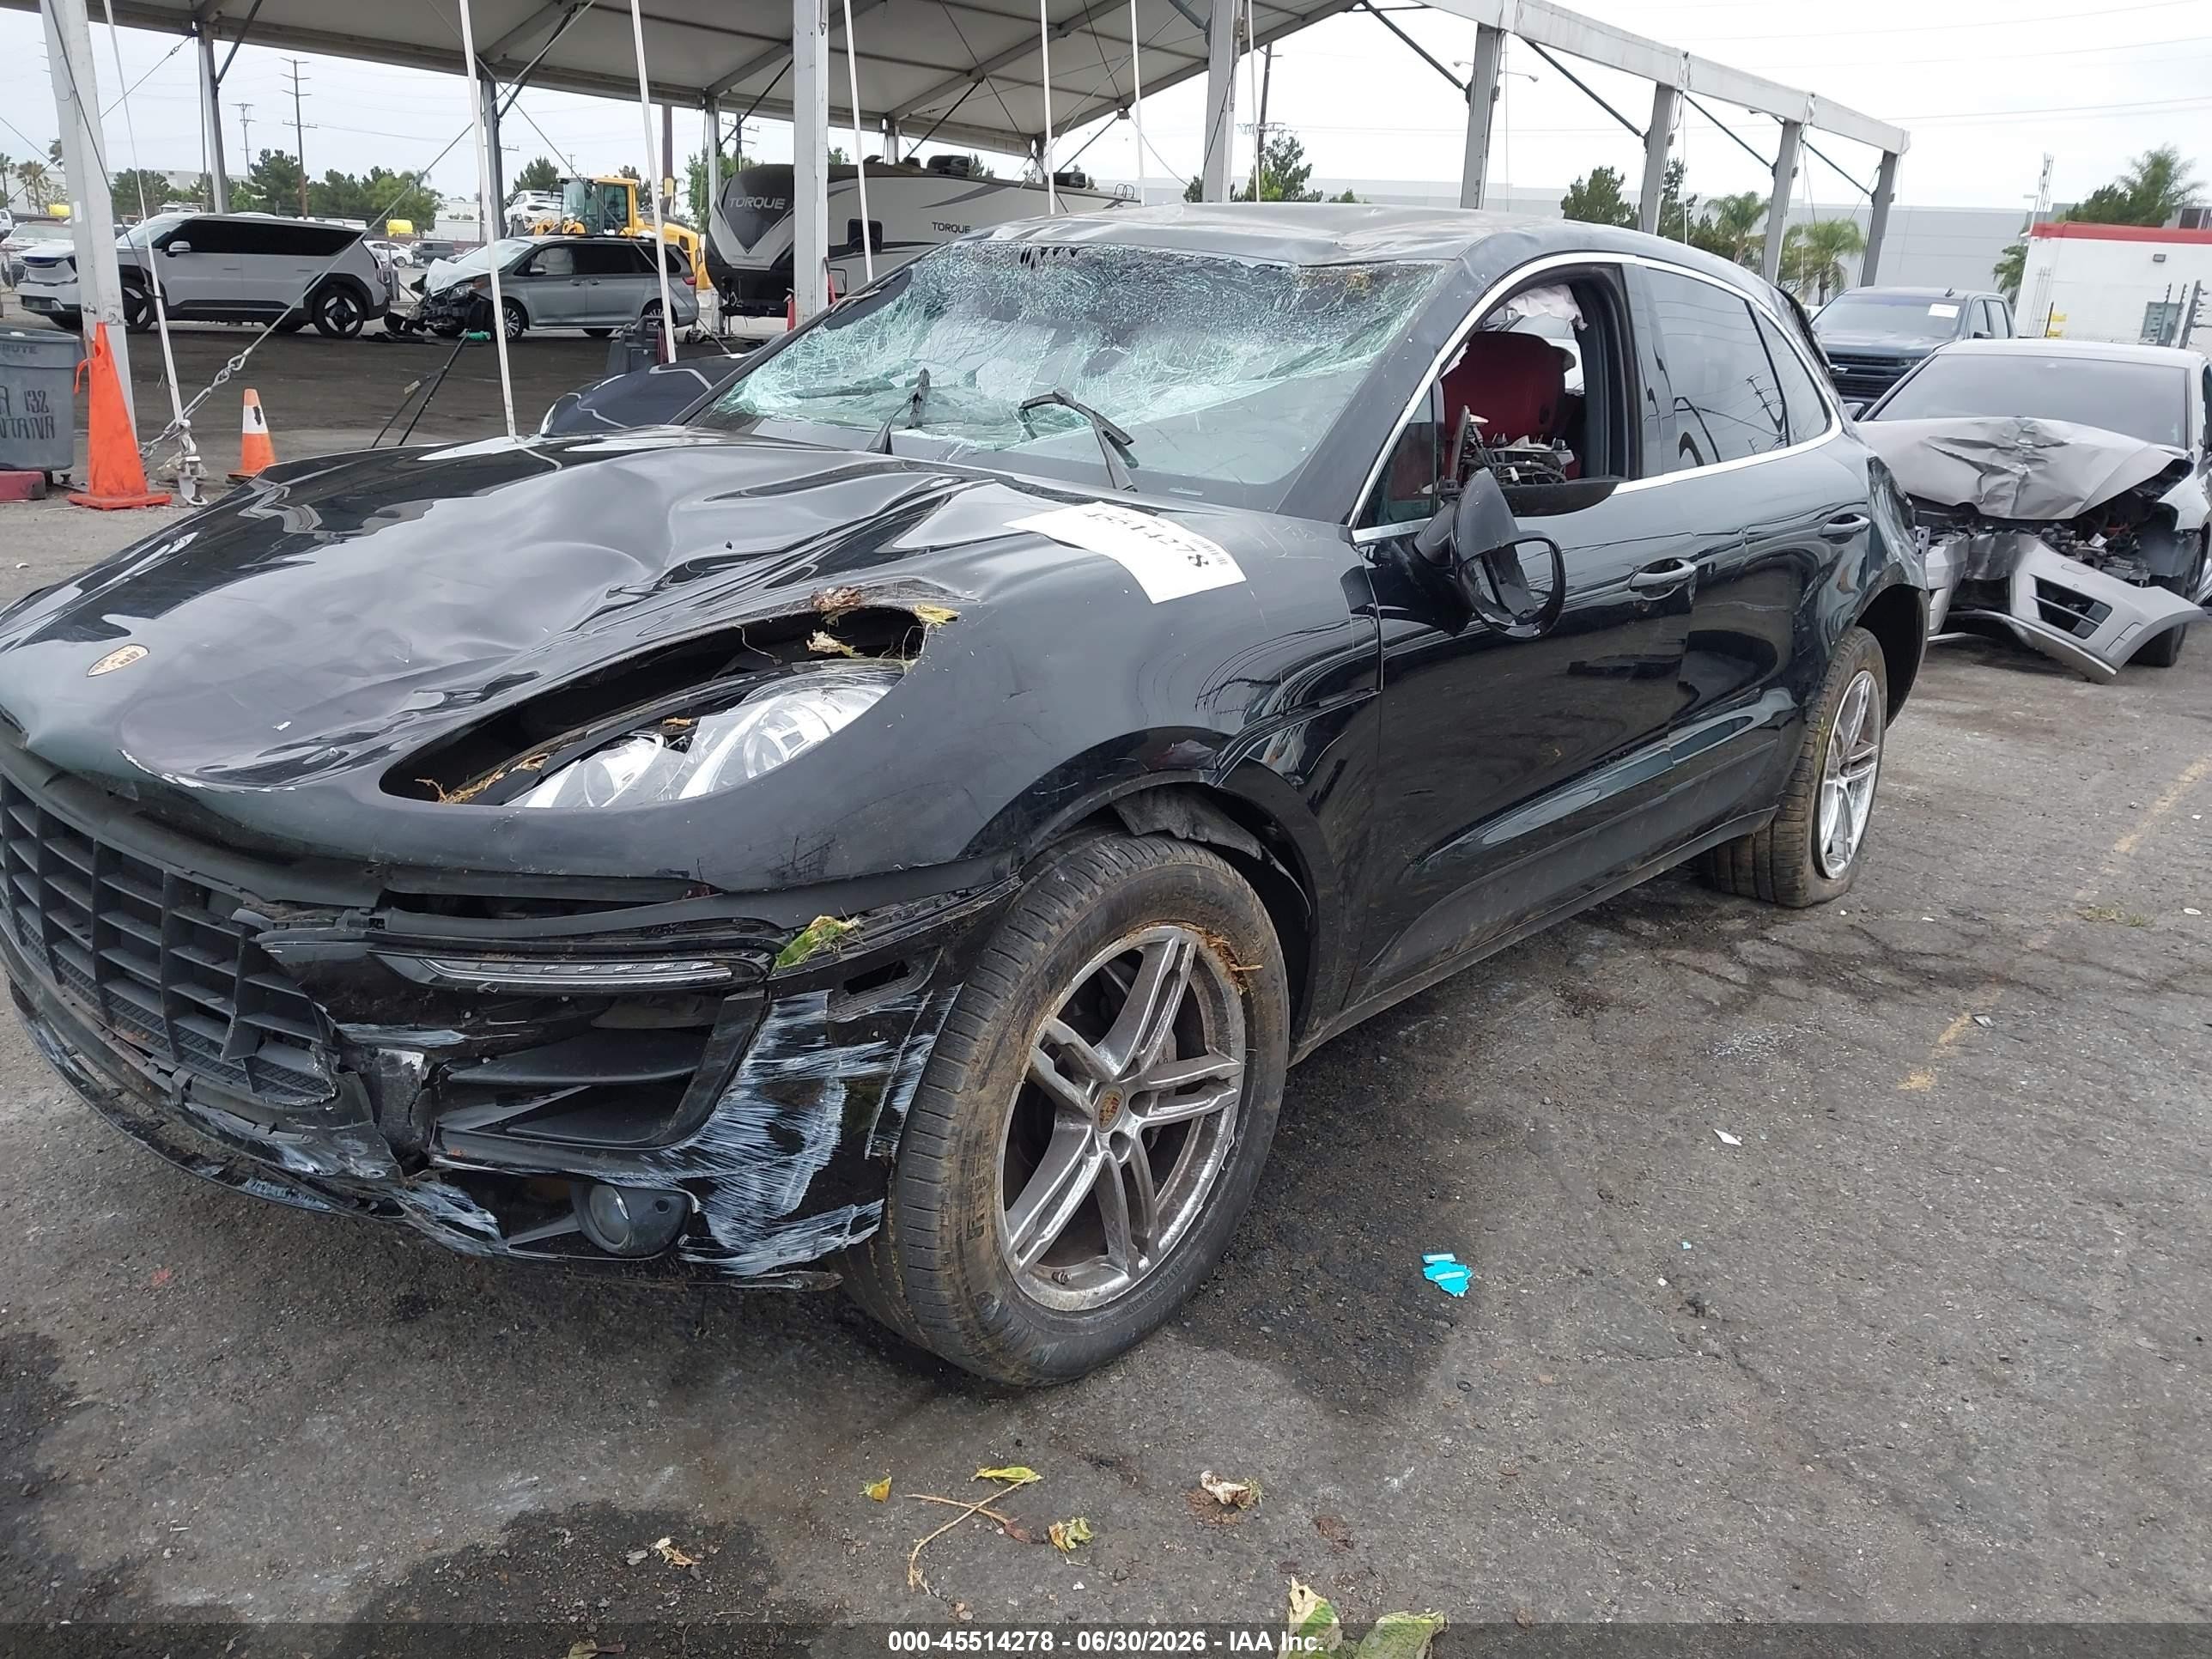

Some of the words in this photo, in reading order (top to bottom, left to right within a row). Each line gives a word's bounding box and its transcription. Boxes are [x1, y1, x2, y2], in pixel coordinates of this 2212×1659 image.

[729, 196, 786, 210] TORQUE
[932, 222, 971, 234] TORQUE
[23, 390, 50, 413] 132
